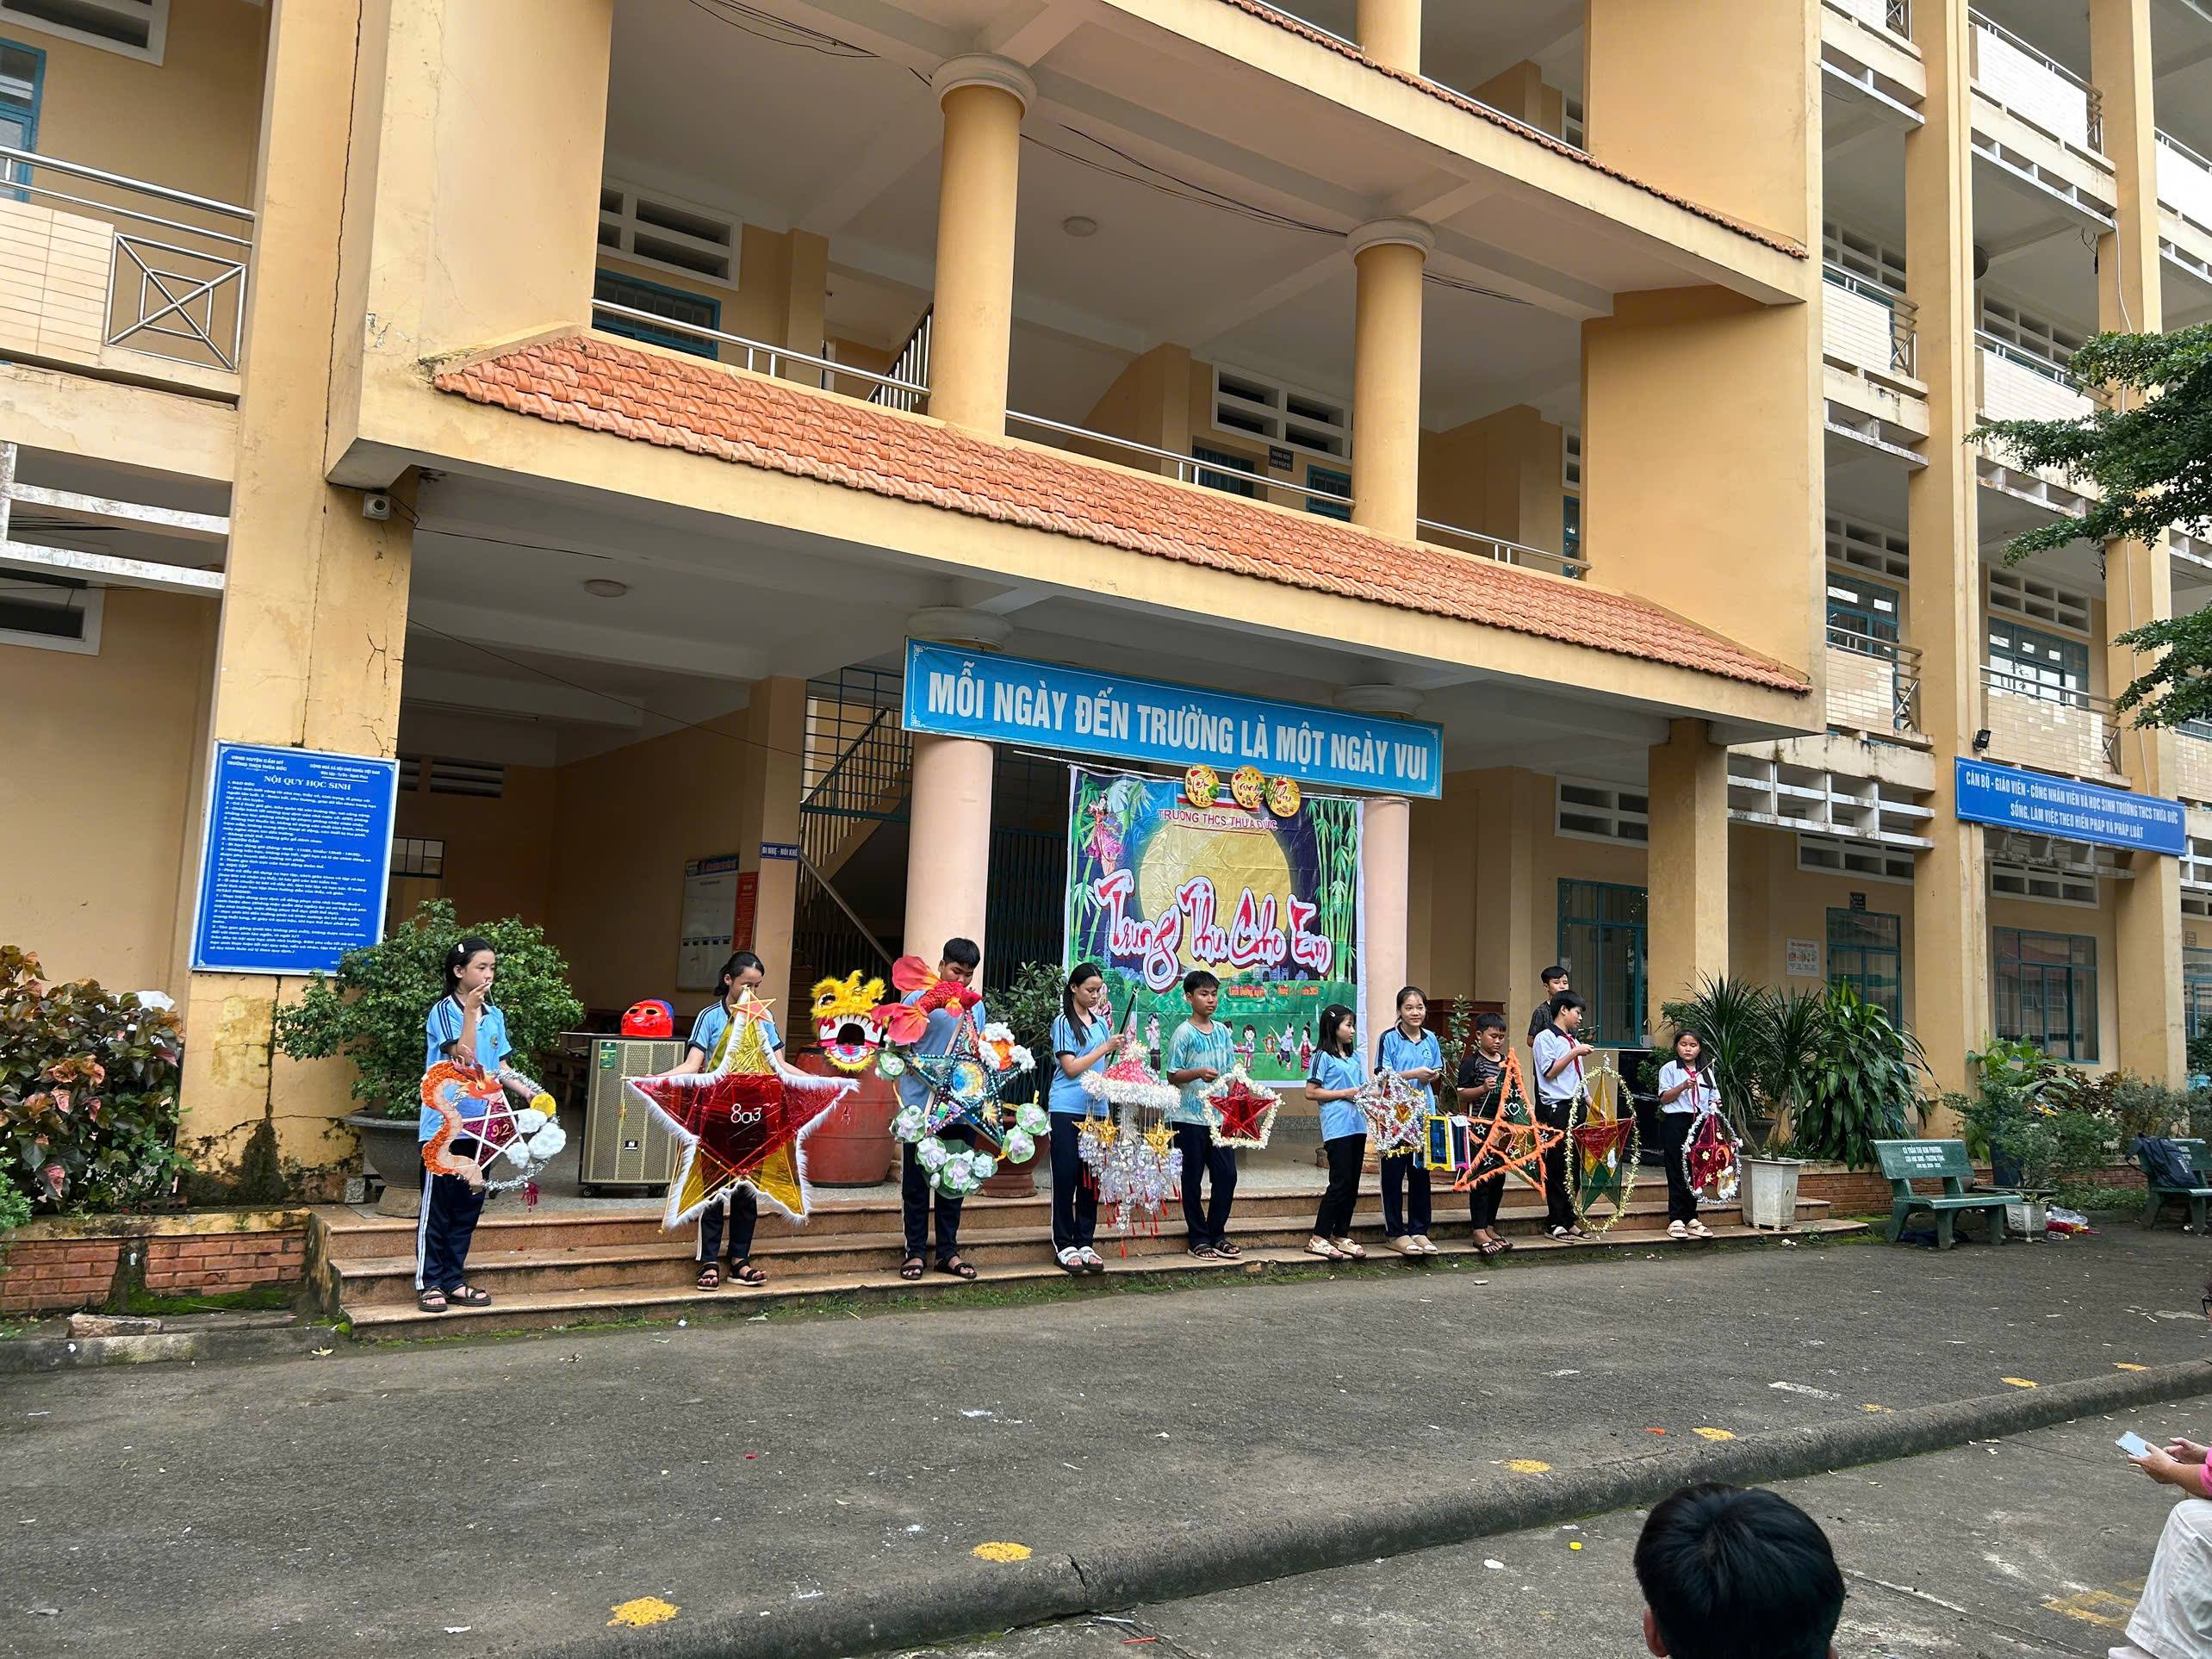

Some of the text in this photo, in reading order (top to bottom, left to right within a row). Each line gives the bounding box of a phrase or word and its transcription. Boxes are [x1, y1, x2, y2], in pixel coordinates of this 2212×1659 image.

[929, 661, 1427, 781] MỖI NGÀY ĐẾN TRƯỜNG LÀ MỘT NGÀY VUI
[264, 775, 351, 791] NỘI QUY HỌC SINH
[1967, 769, 1979, 787] CÁN
[1981, 773, 1990, 791] BỘ
[1995, 775, 2010, 793] GIÁO
[2010, 779, 2026, 796] VIÊN
[2030, 782, 2047, 801] CÔNG
[2048, 787, 2066, 805] NHÂN
[2066, 790, 2080, 806] VIÊN
[2080, 792, 2090, 809] VÀ
[2090, 794, 2101, 812] HỌC
[2102, 798, 2116, 813] SINH
[2116, 800, 2138, 818] TRƯỜNG
[2138, 805, 2153, 820] THCS
[2153, 806, 2167, 822] THỪA
[2167, 809, 2178, 824] ĐỨC
[1202, 813, 1227, 826] THCS
[2010, 799, 2143, 841] SỐNG, LÀM VIỆC THEO HIẾN PHÁP VÀ PHÁP LUẬT
[1094, 868, 1333, 991] Trung Thu Cho Em
[730, 1103, 761, 1123] 8a3
